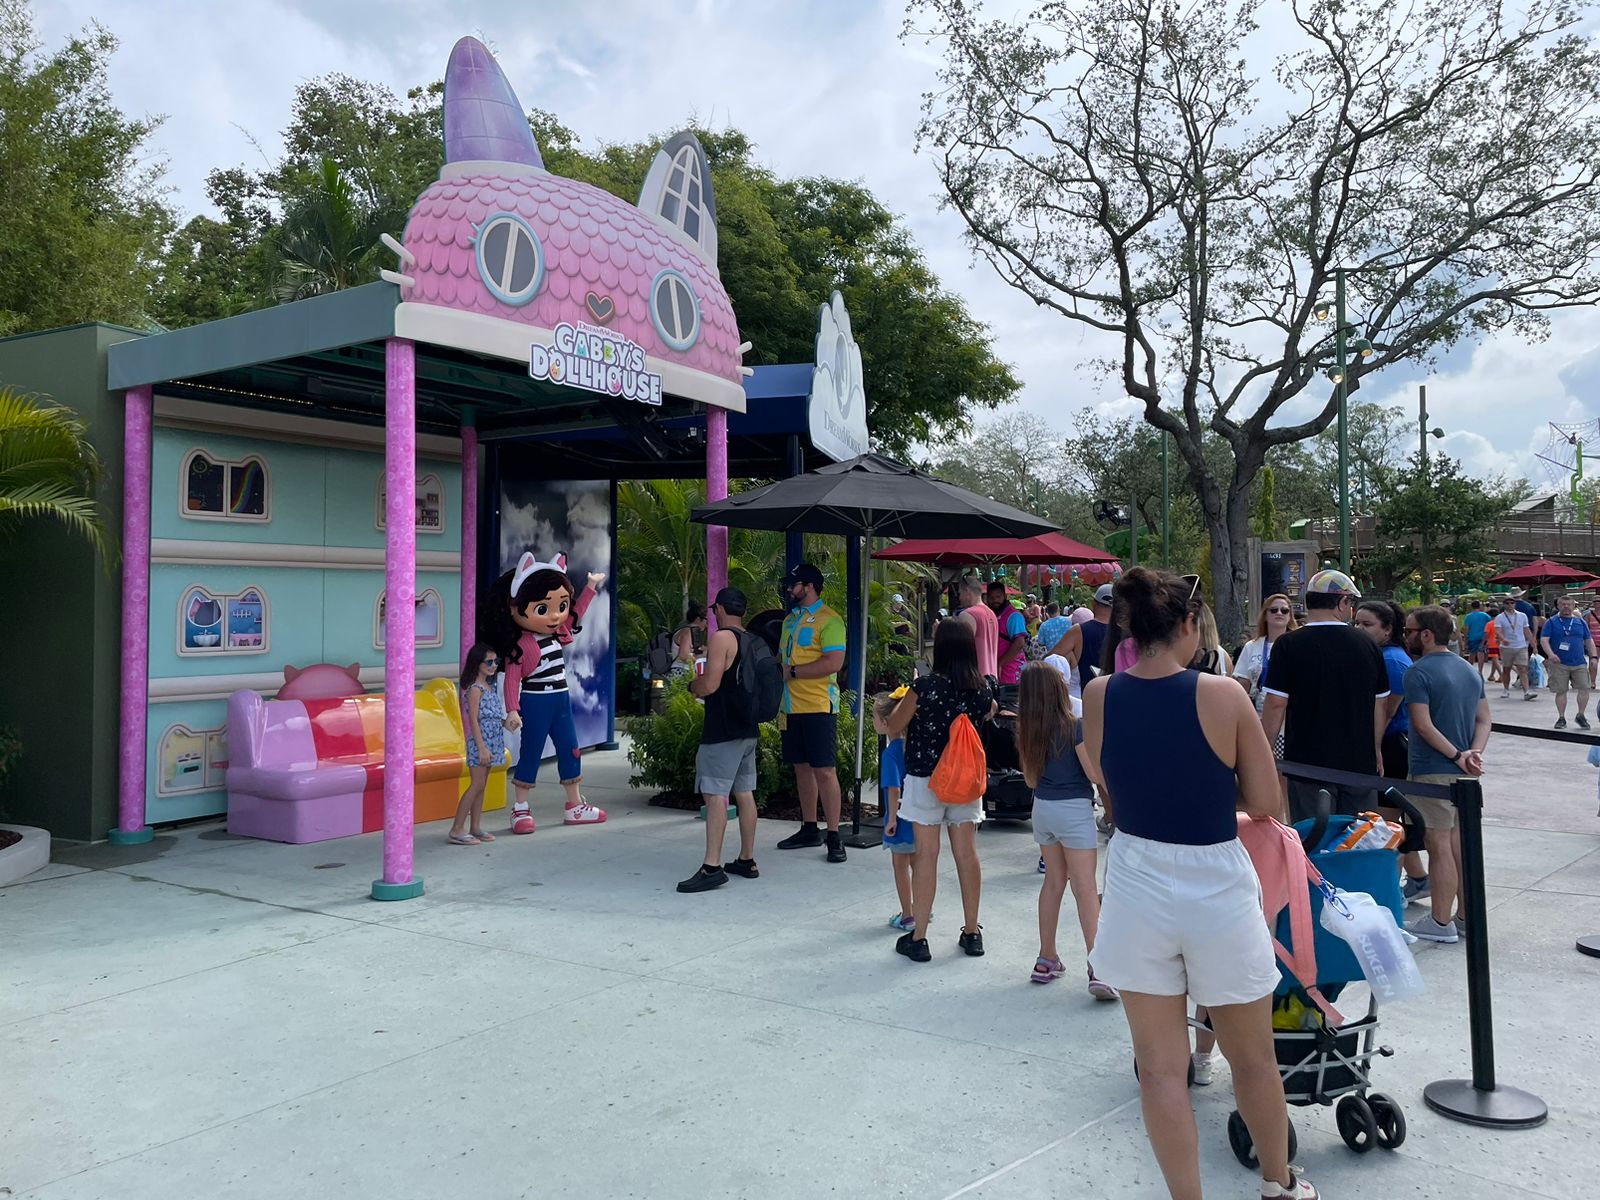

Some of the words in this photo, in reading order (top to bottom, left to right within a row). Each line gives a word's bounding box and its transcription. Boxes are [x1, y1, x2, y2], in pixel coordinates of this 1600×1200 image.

[531, 344, 662, 405] DOLLHOUSE
[555, 323, 645, 372] GABBY'S
[1358, 933, 1395, 998] SUKEEN
